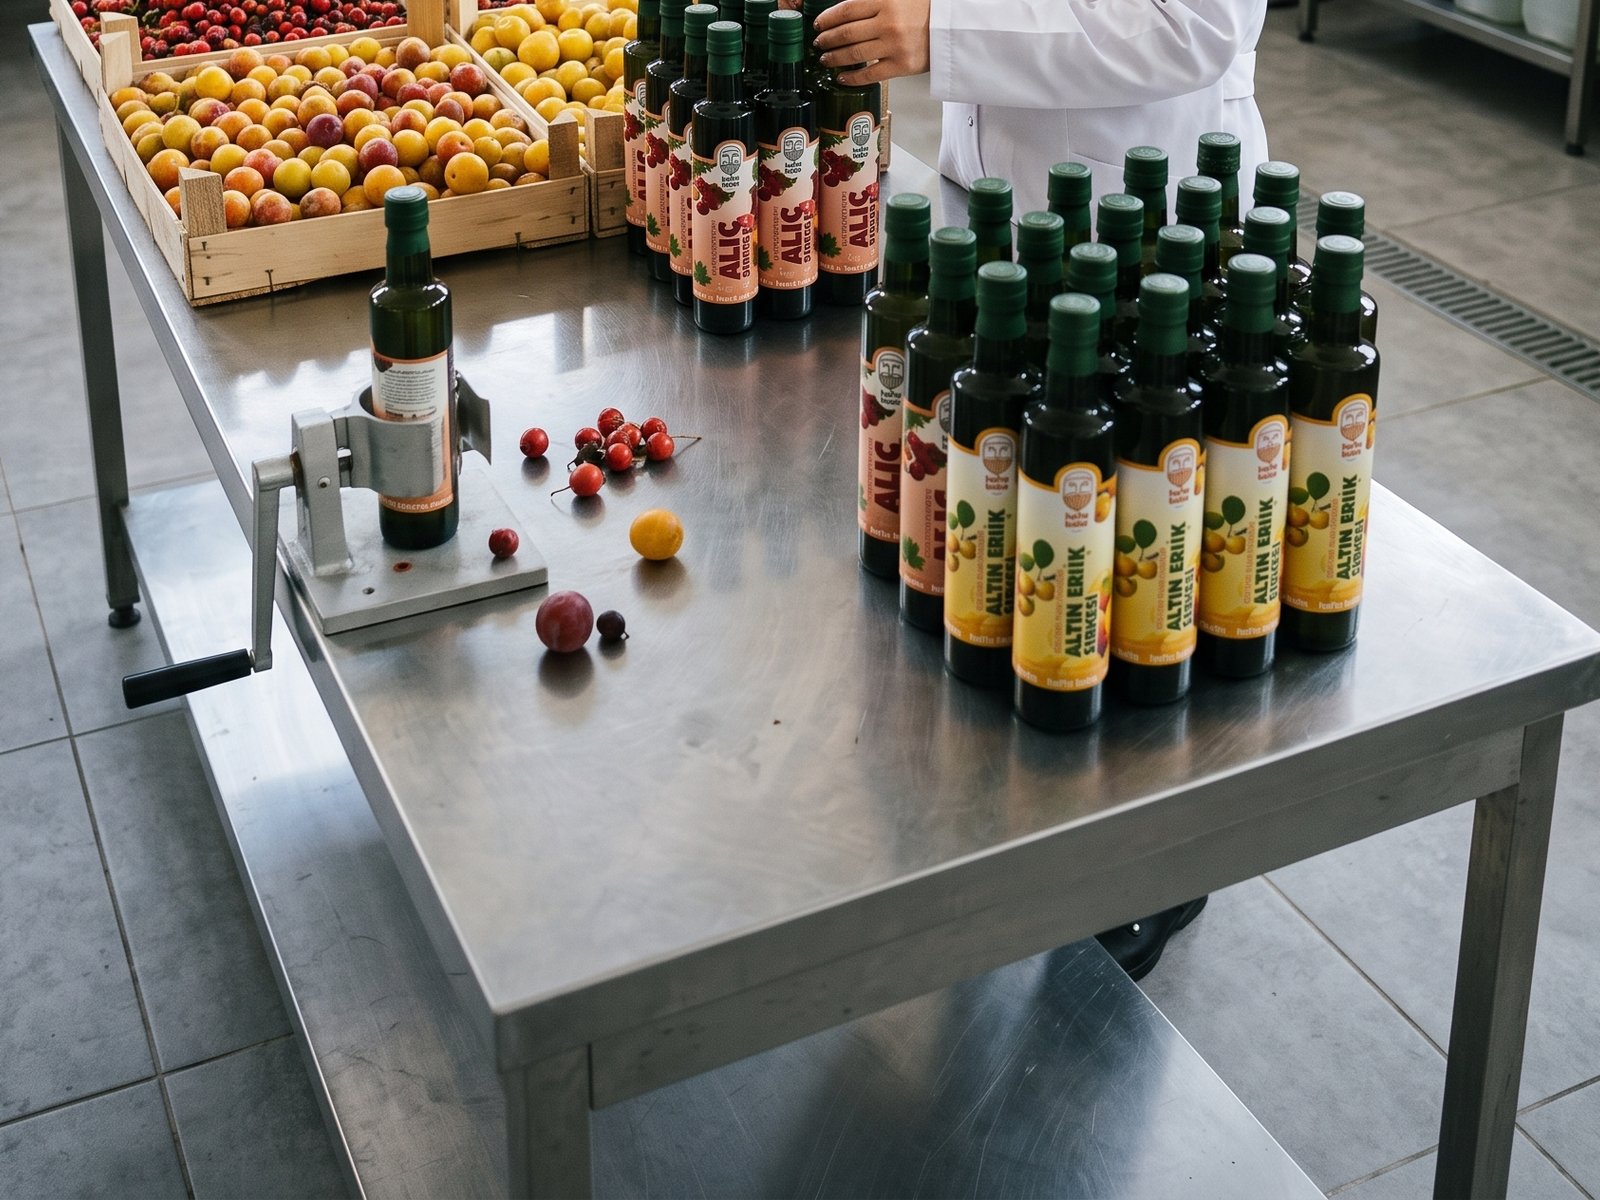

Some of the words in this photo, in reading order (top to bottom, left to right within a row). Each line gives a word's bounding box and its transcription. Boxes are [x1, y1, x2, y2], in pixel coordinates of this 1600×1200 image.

[780, 202, 804, 265] ALIC
[848, 189, 870, 248] ALIC
[717, 216, 742, 281] ALIC
[874, 440, 901, 514] ALIC
[1254, 552, 1270, 604] ALTIN
[1336, 528, 1353, 580] ALTIN
[985, 563, 1003, 617] ALTIN
[1167, 578, 1183, 631] ALTIN
[1065, 603, 1083, 658] ALTIN
